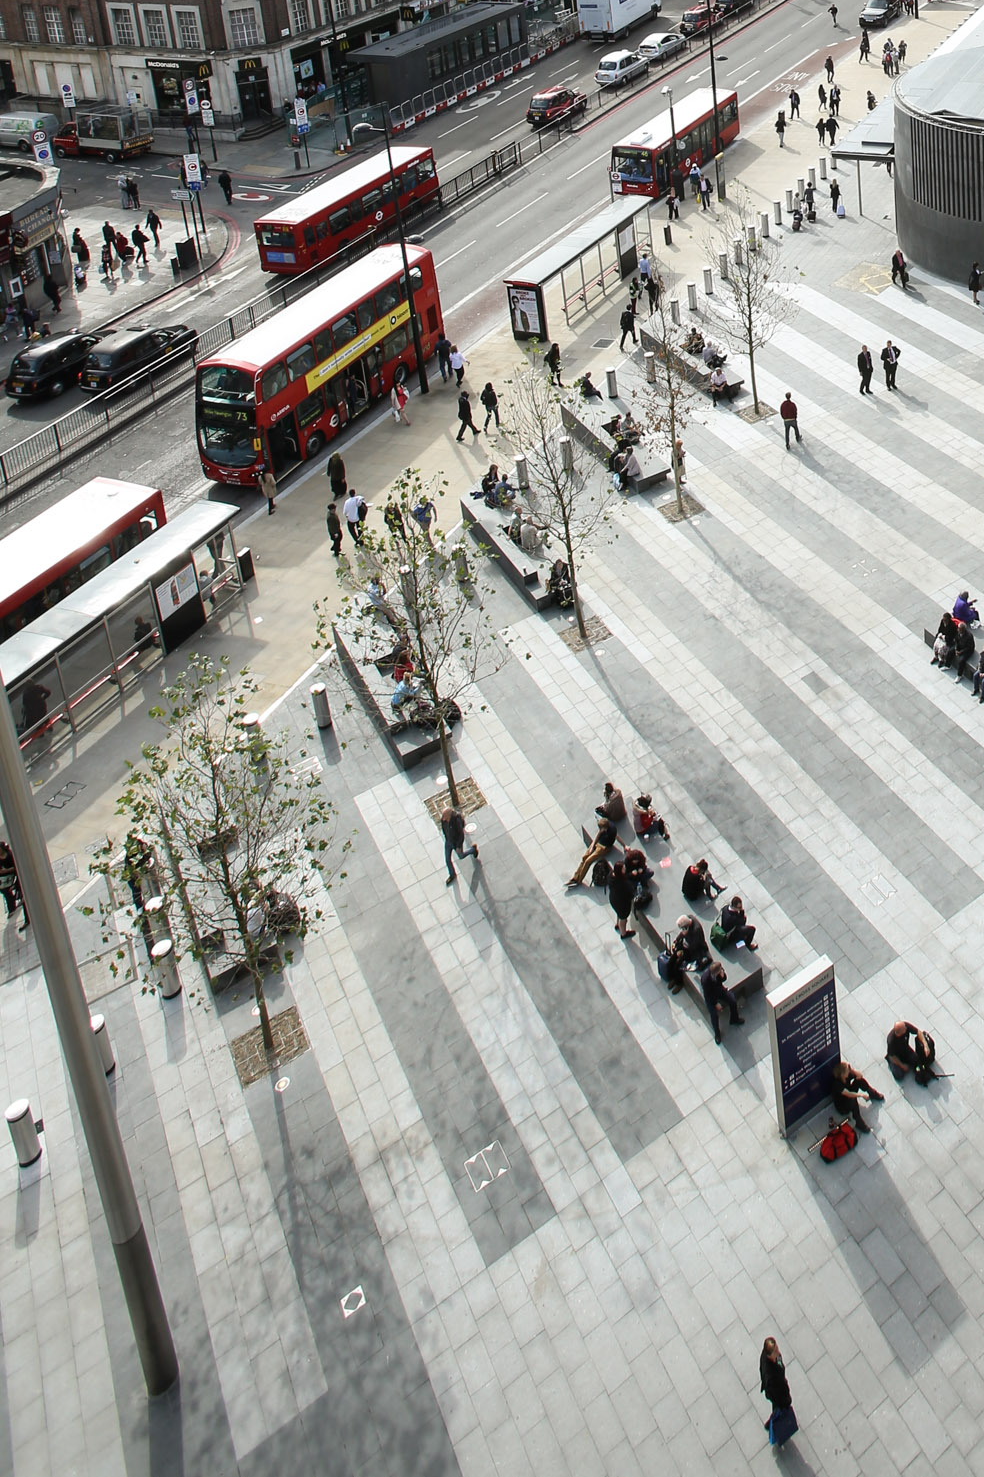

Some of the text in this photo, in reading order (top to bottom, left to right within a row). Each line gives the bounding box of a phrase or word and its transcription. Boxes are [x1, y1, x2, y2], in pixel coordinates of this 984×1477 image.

[147, 60, 179, 69] McDonald's
[276, 404, 290, 417] ARRIVA
[236, 411, 248, 421] 73
